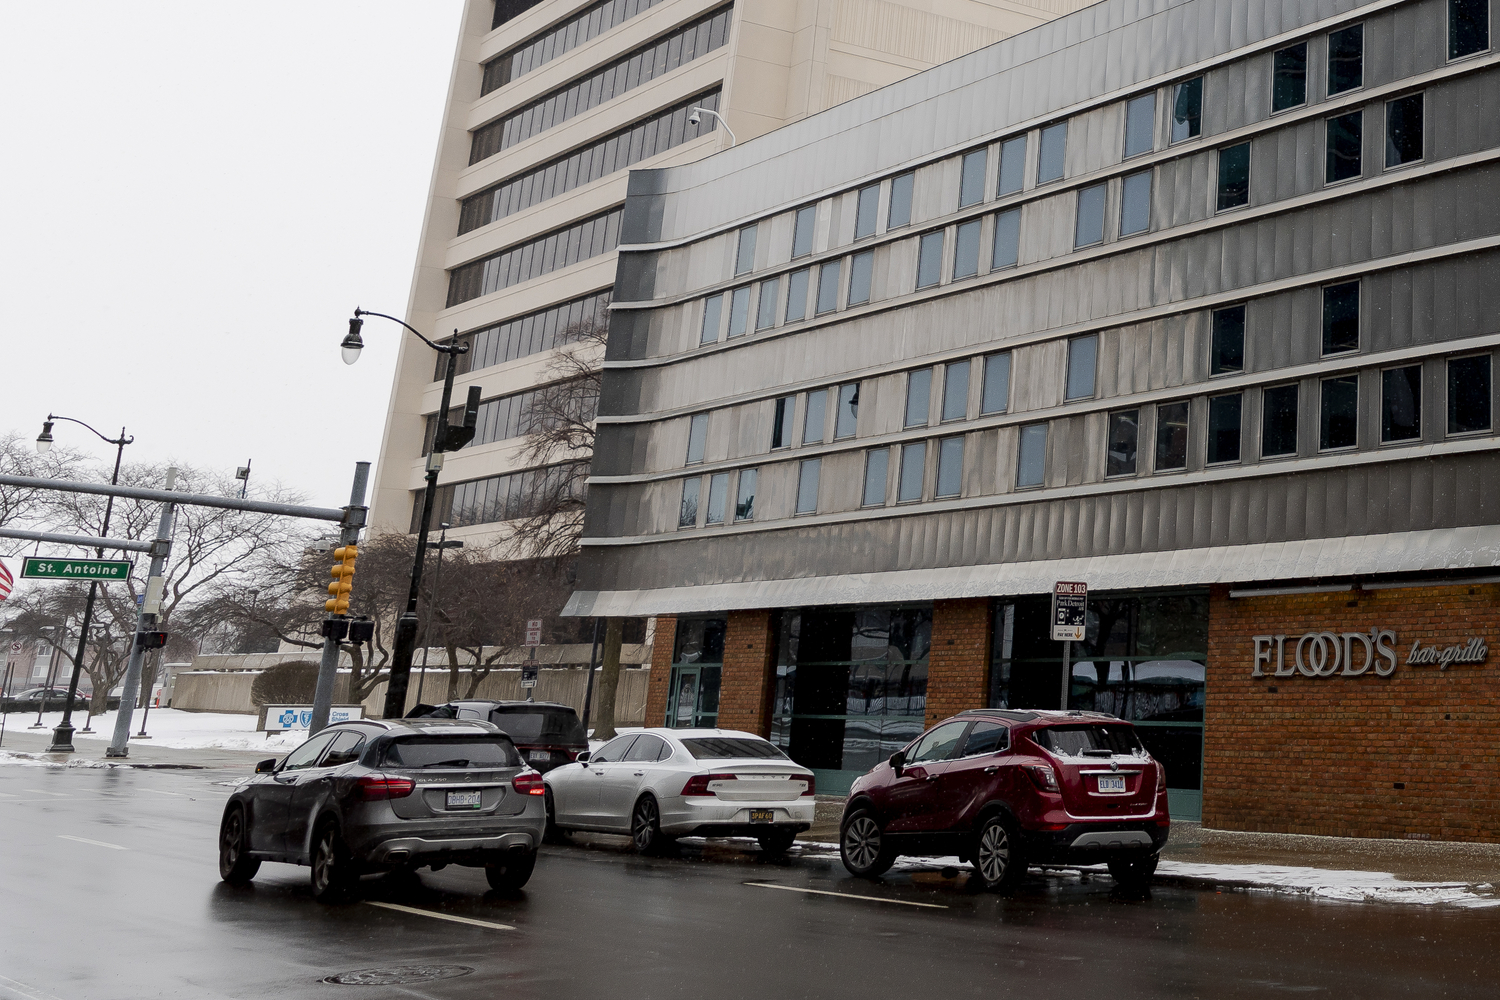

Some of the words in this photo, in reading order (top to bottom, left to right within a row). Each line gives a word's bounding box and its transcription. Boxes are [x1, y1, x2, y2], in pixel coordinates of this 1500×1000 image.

[38, 563, 56, 573] St.
[63, 564, 118, 575] Antoine
[1057, 583, 1073, 593] ZONE
[1074, 584, 1086, 593] 103
[1252, 627, 1398, 677] FLOOD'S
